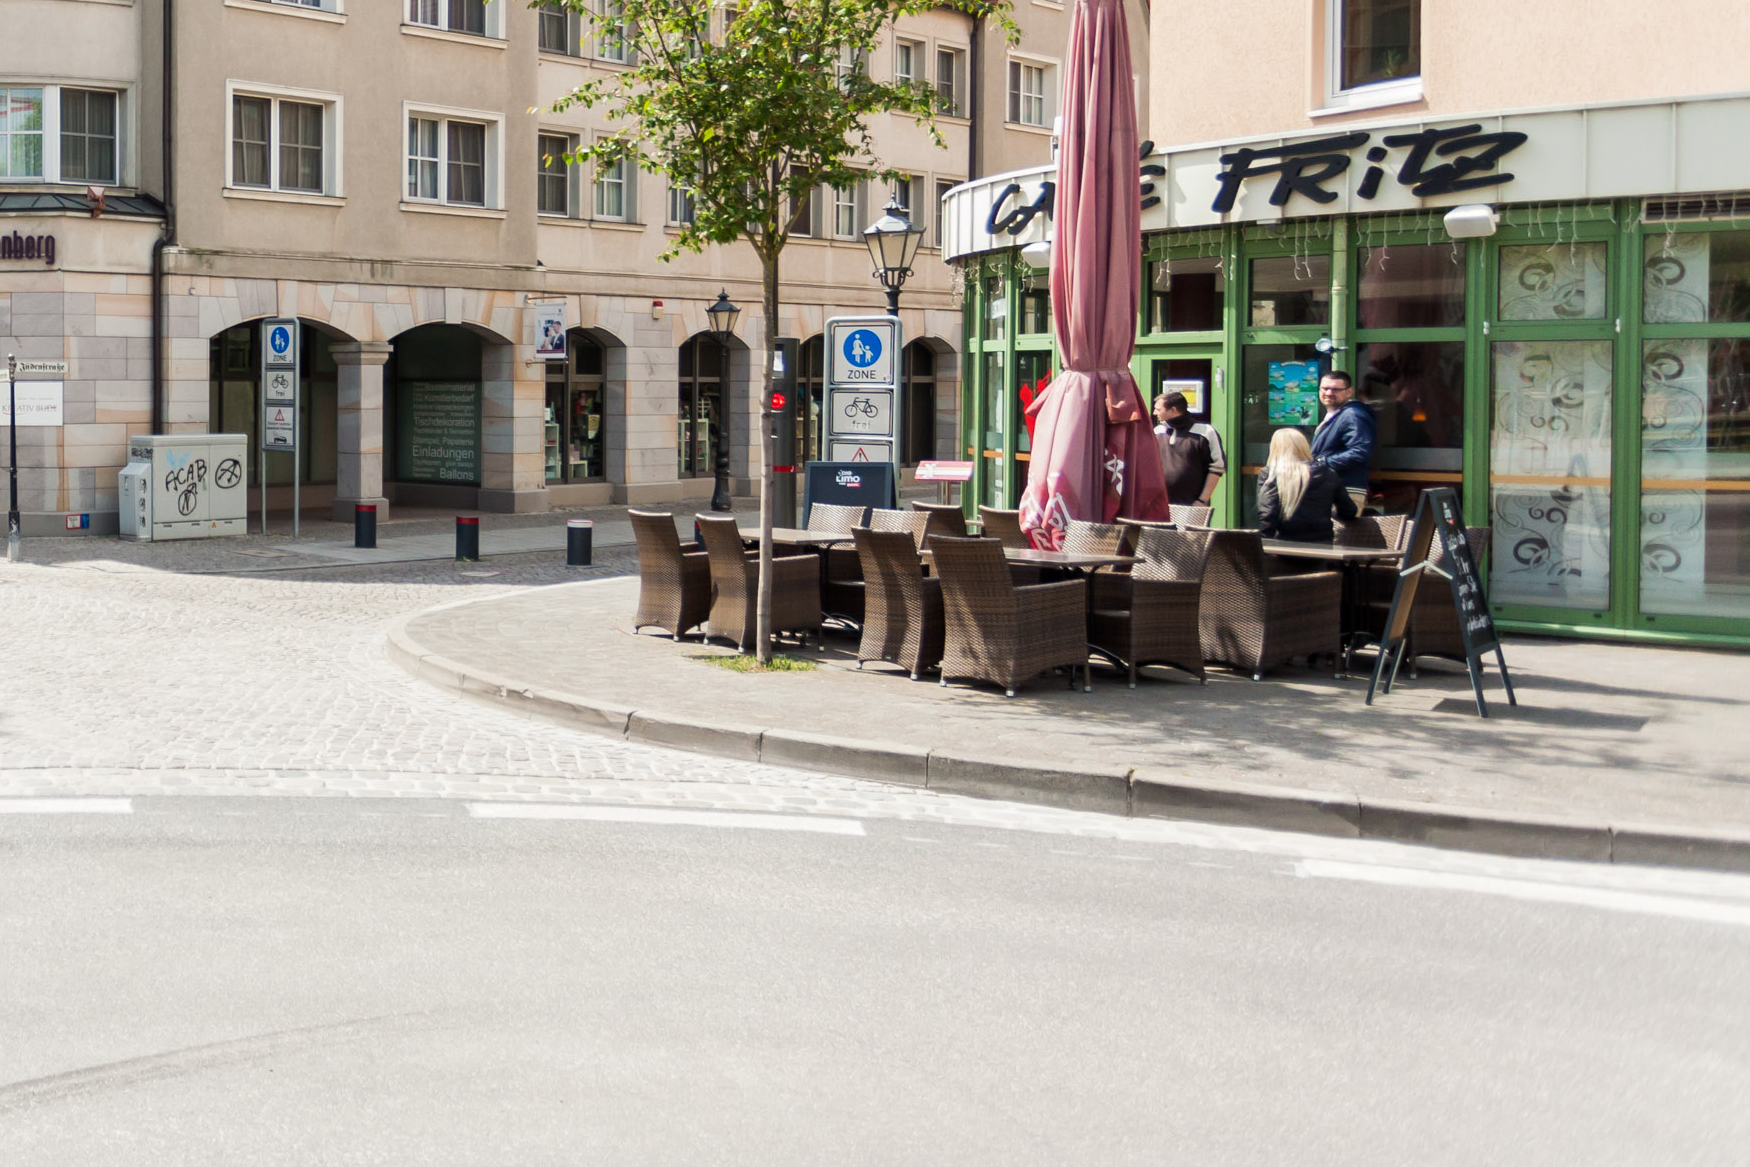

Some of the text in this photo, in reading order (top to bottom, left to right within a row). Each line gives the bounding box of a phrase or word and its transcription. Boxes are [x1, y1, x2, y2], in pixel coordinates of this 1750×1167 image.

[273, 354, 287, 362] ZONE
[847, 369, 877, 380] ZONE
[414, 416, 475, 427] Tischdekoration
[413, 445, 474, 461] Einladungen
[165, 459, 207, 491] ACAB
[440, 467, 474, 480] Ballons
